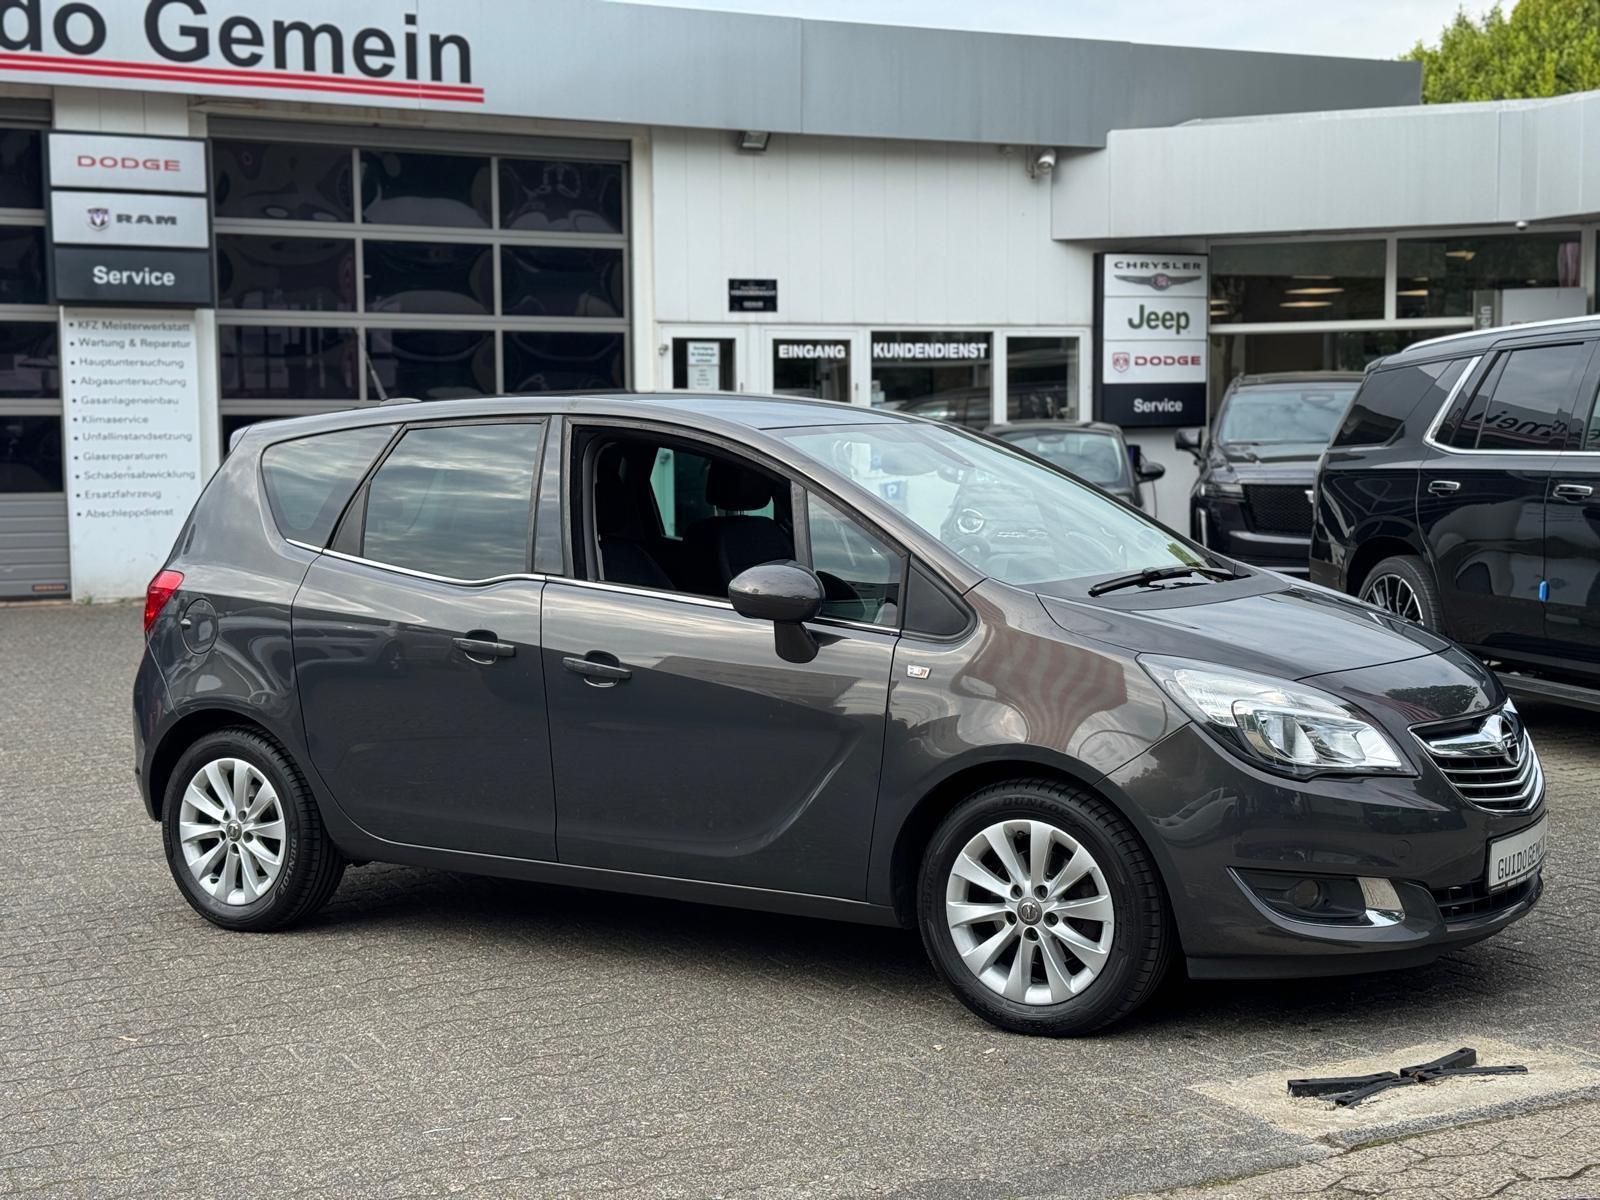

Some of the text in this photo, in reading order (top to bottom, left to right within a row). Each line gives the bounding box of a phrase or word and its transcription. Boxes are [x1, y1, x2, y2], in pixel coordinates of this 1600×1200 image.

[144, 0, 472, 84] Gemein
[77, 155, 181, 172] DODGE
[116, 213, 177, 225] RAM
[1114, 261, 1202, 270] CHRYSLER
[93, 265, 175, 286] Service
[1127, 304, 1190, 335] Jeep
[78, 321, 190, 332] KFZ Meisterwerkstatt
[79, 338, 191, 349] Wartung & Reparatur
[778, 345, 846, 359] EINGANG
[873, 342, 988, 359] KUNDENDIENST
[79, 357, 184, 369] Hauptuntersuchung
[1134, 356, 1201, 366] DODGE
[80, 376, 186, 388] Abgasuntersuchung
[81, 396, 180, 407] Gasanlageneinbau
[1133, 398, 1183, 413] Service
[82, 414, 149, 424] Klimaservice
[82, 432, 193, 443] Unfallinstandsetzung
[82, 451, 168, 462] Glasreparaturen
[84, 470, 196, 481] Schadensabwicklung
[85, 490, 162, 500] Ersatzfahrzeug
[86, 507, 174, 518] Abschleppdienst
